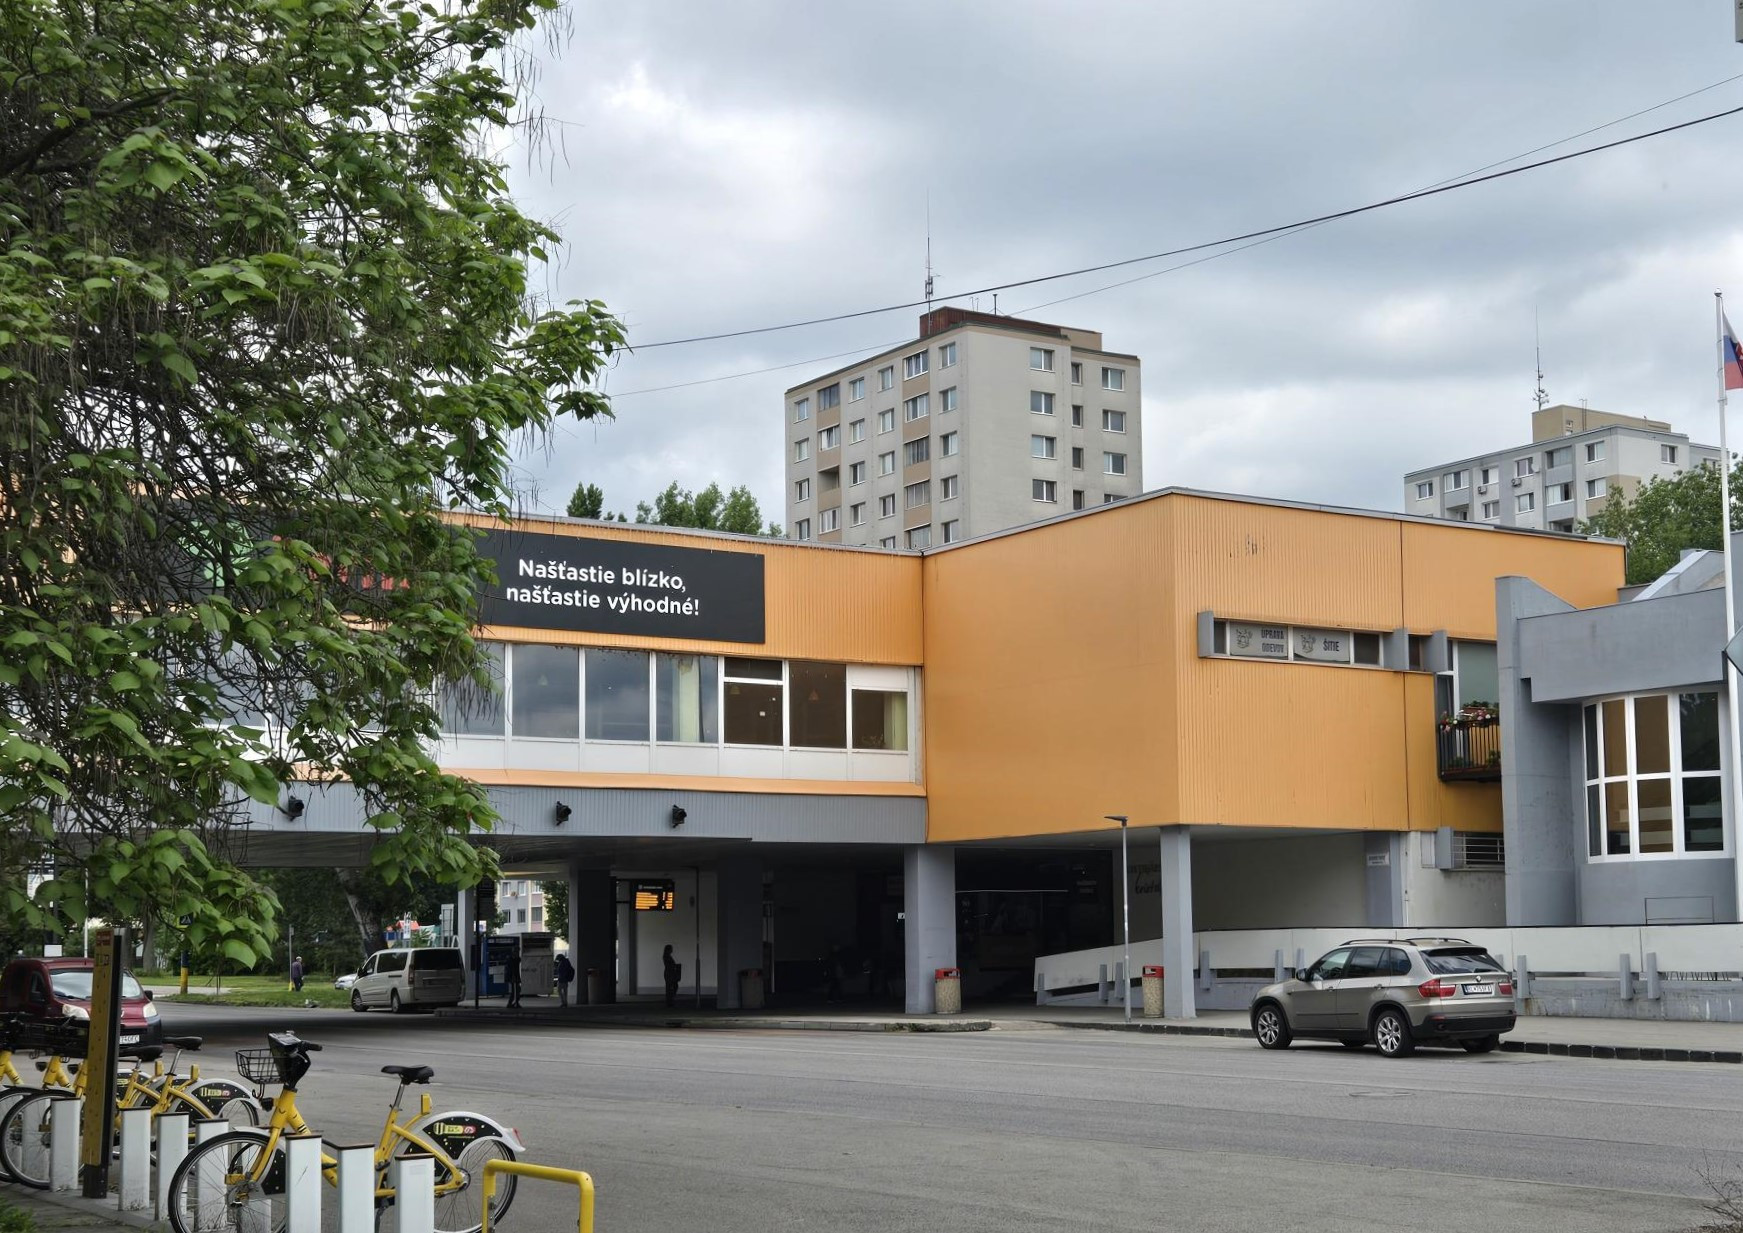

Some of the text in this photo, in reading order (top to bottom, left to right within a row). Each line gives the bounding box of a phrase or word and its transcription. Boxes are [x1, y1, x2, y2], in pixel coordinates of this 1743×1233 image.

[518, 558, 687, 593] Našťastie blízko,
[506, 584, 699, 616] našťastie výhodné!
